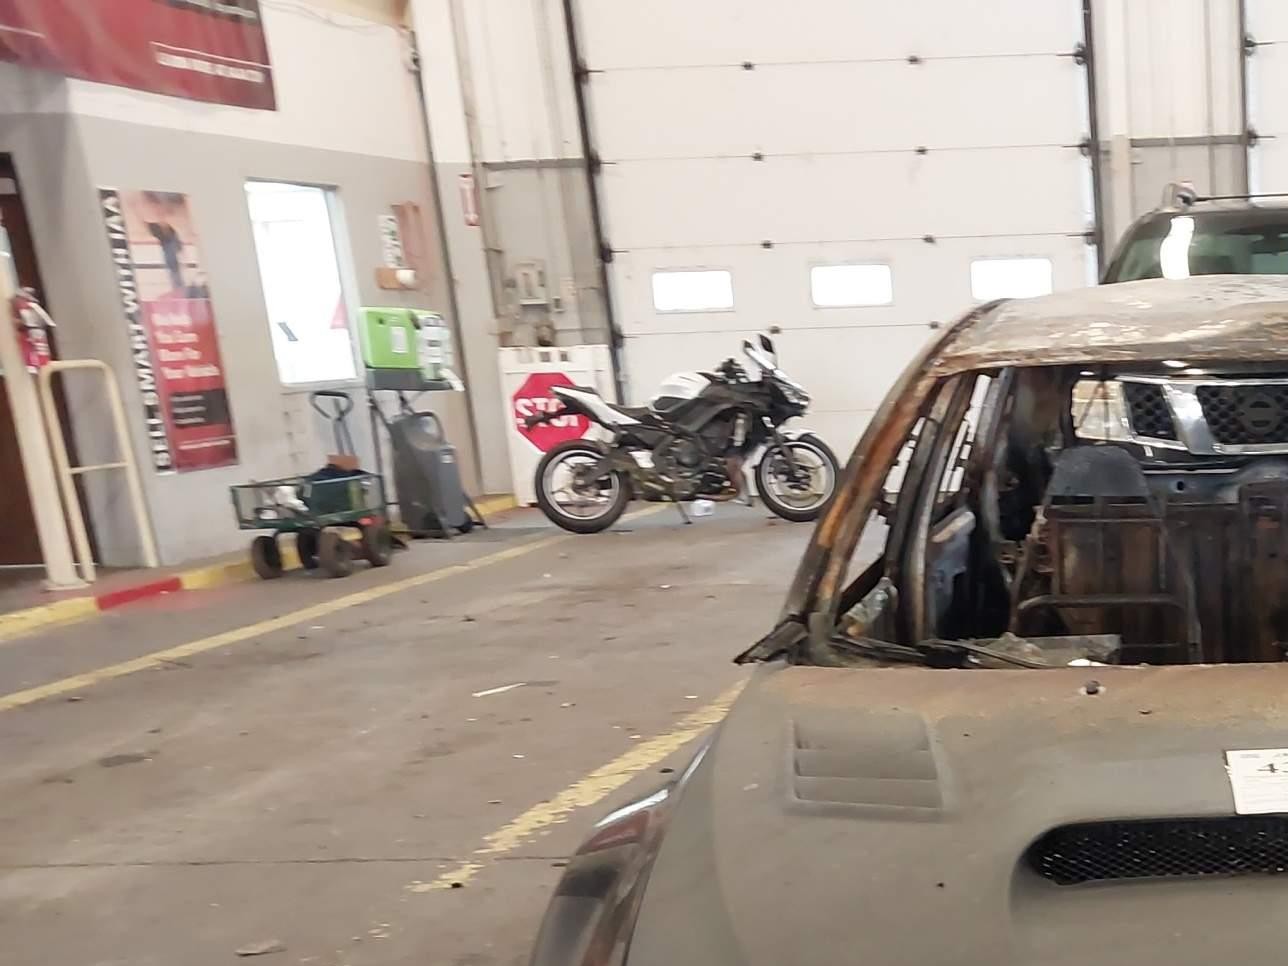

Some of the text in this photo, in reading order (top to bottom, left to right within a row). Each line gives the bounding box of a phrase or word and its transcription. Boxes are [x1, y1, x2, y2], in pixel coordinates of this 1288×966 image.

[103, 197, 171, 466] SELL SMART WITH IAA
